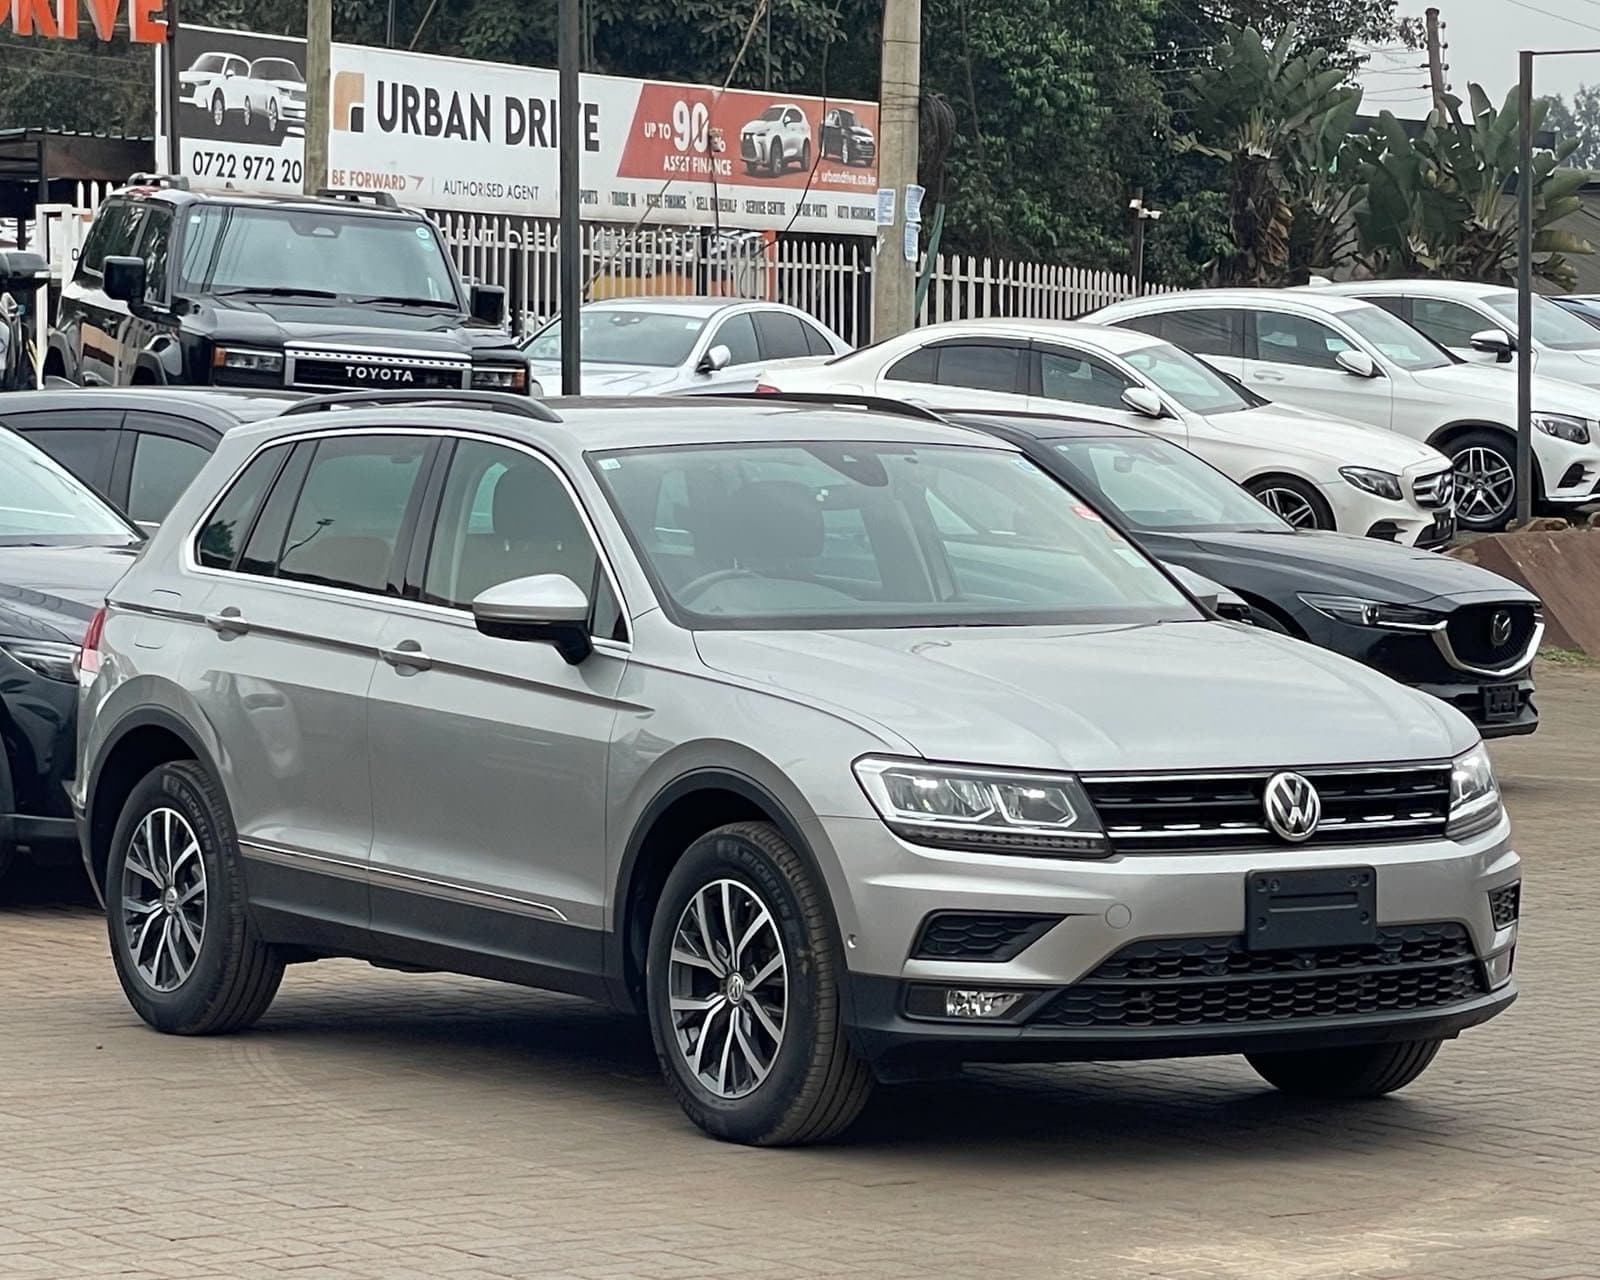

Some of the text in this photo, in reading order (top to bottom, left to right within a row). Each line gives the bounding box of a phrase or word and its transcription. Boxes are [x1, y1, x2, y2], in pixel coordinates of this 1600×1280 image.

[0, 0, 168, 43] RIVE
[376, 80, 600, 152] URBAN DRIE
[644, 122, 657, 138] UP
[658, 123, 671, 140] TO
[192, 151, 303, 184] 0722 972 20
[692, 156, 732, 176] FINANCE
[332, 170, 406, 191] BE FORWARD
[443, 180, 540, 201] AUTHORISED AGENT
[345, 366, 414, 382] TOYOTA
[1265, 771, 1321, 842] VW
